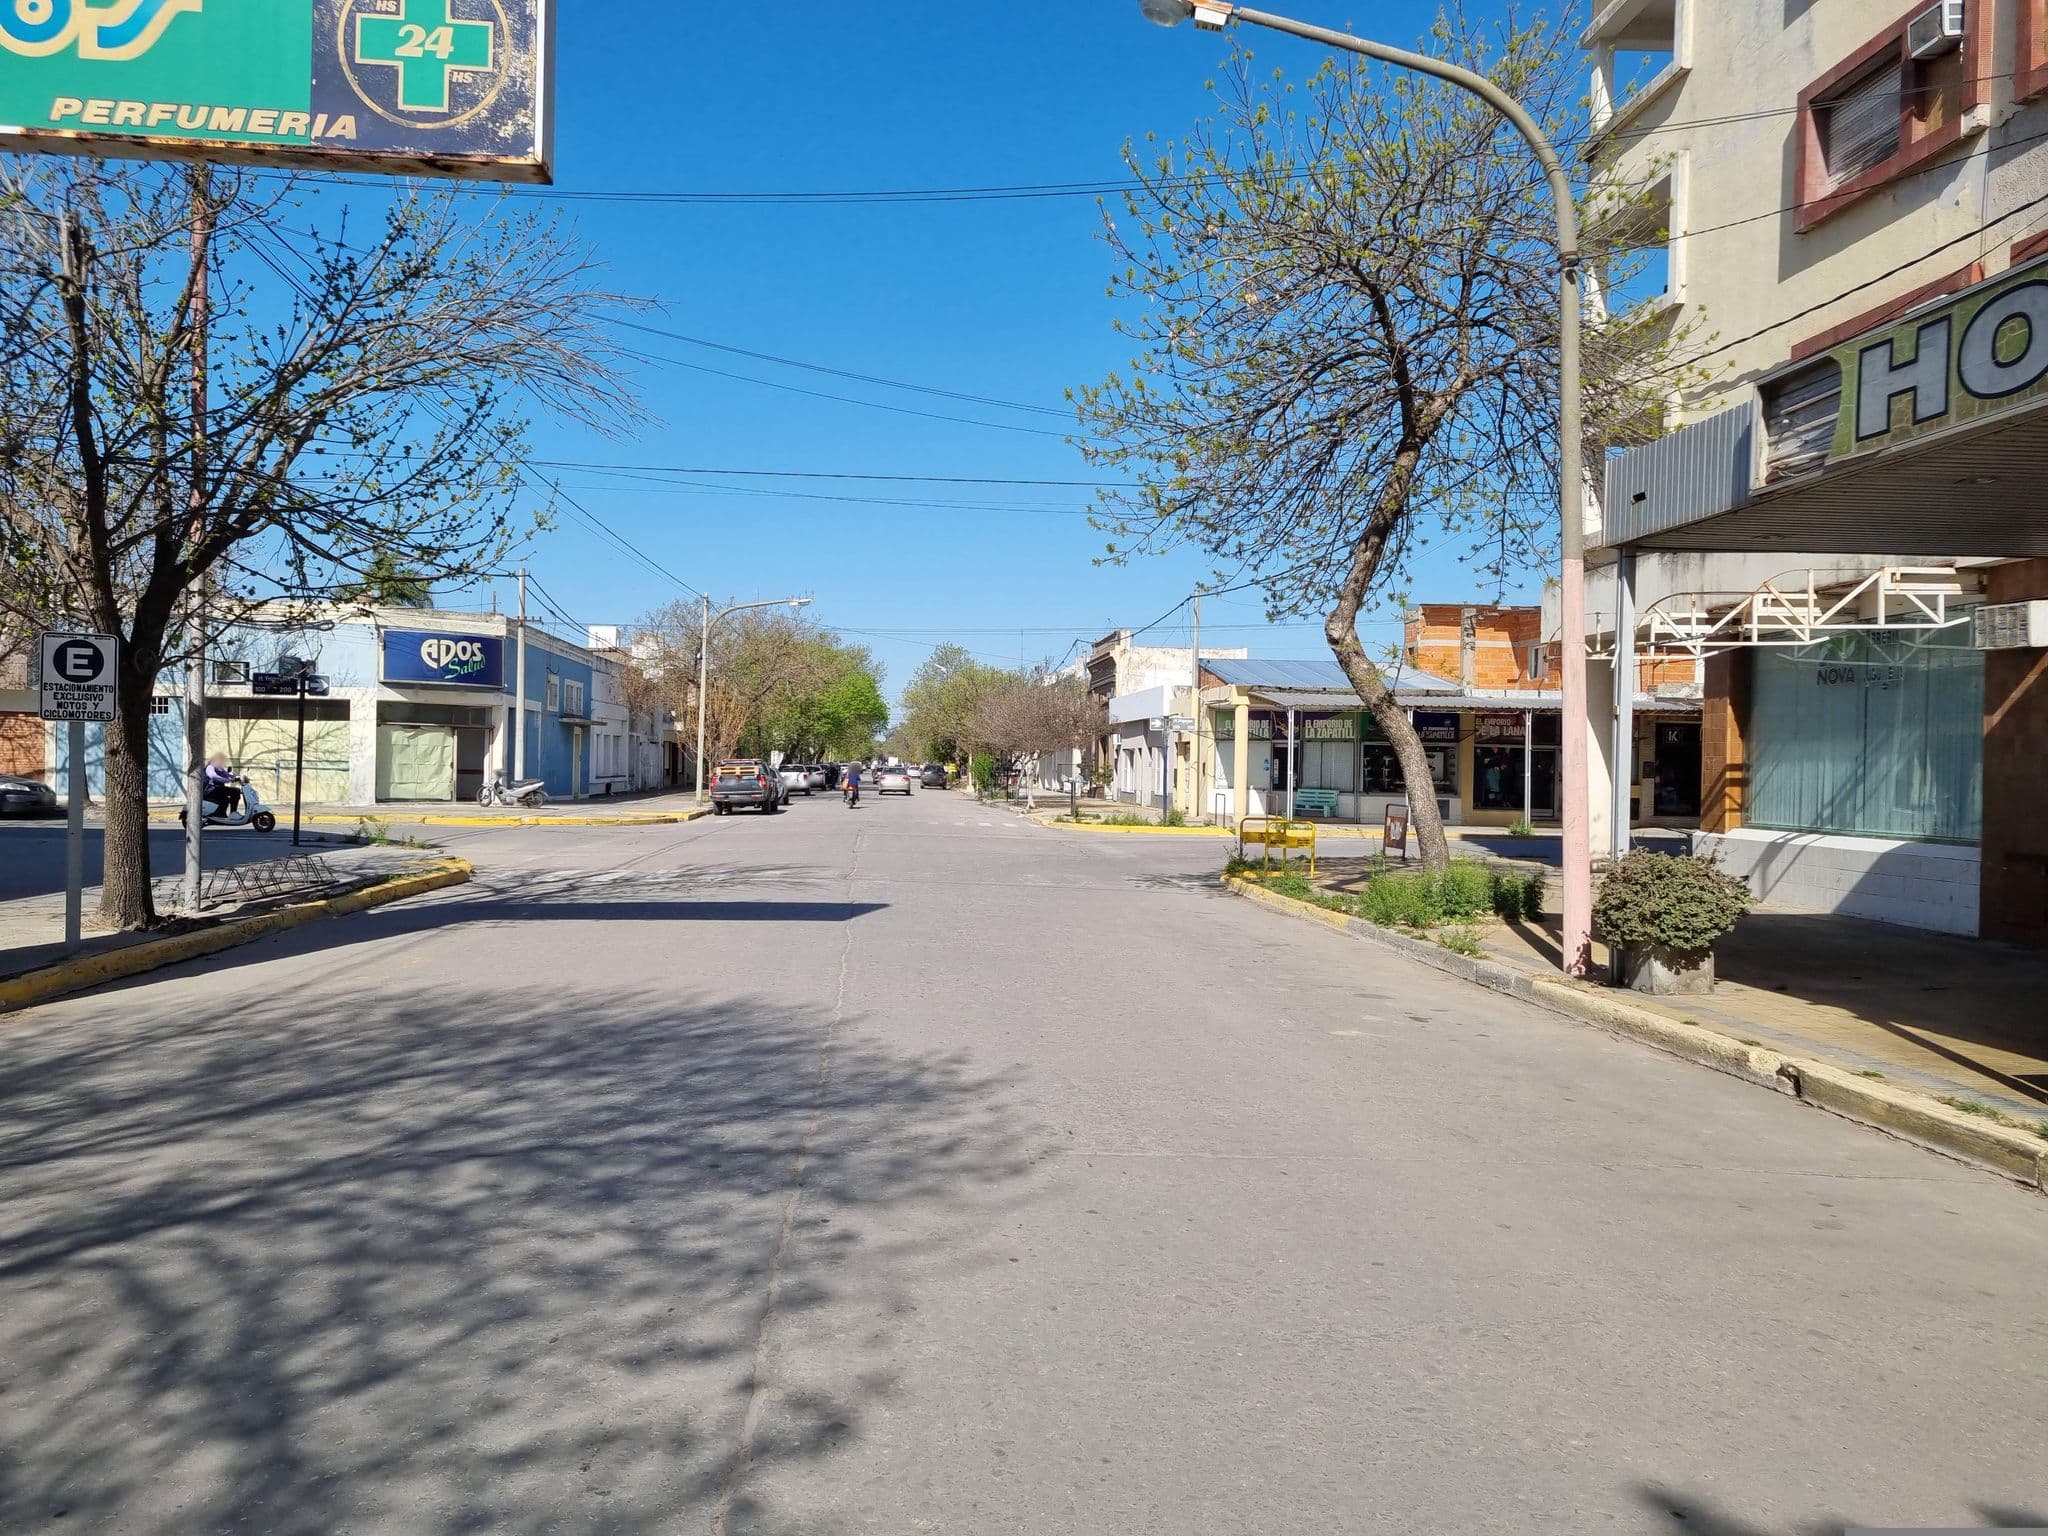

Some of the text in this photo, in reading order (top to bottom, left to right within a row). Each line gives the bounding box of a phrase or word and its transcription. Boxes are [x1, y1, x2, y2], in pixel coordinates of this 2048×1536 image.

[376, 0, 397, 12] HS
[394, 24, 454, 59] 24
[452, 71, 474, 83] HS
[49, 97, 357, 140] PERFUMERIA
[1856, 279, 2048, 443] HO
[421, 639, 481, 669] ADOS
[66, 647, 93, 676] E
[1816, 667, 1856, 685] NOVA
[43, 683, 114, 693] ESTACIONAMIENTO
[53, 692, 104, 702] EXCLUSIVO
[56, 701, 99, 710] MOTOS Y
[43, 709, 112, 719] CICLOMOTORES
[1305, 720, 1353, 728] EL EMPORIO DE
[1305, 728, 1355, 738] LA ZAPATILL
